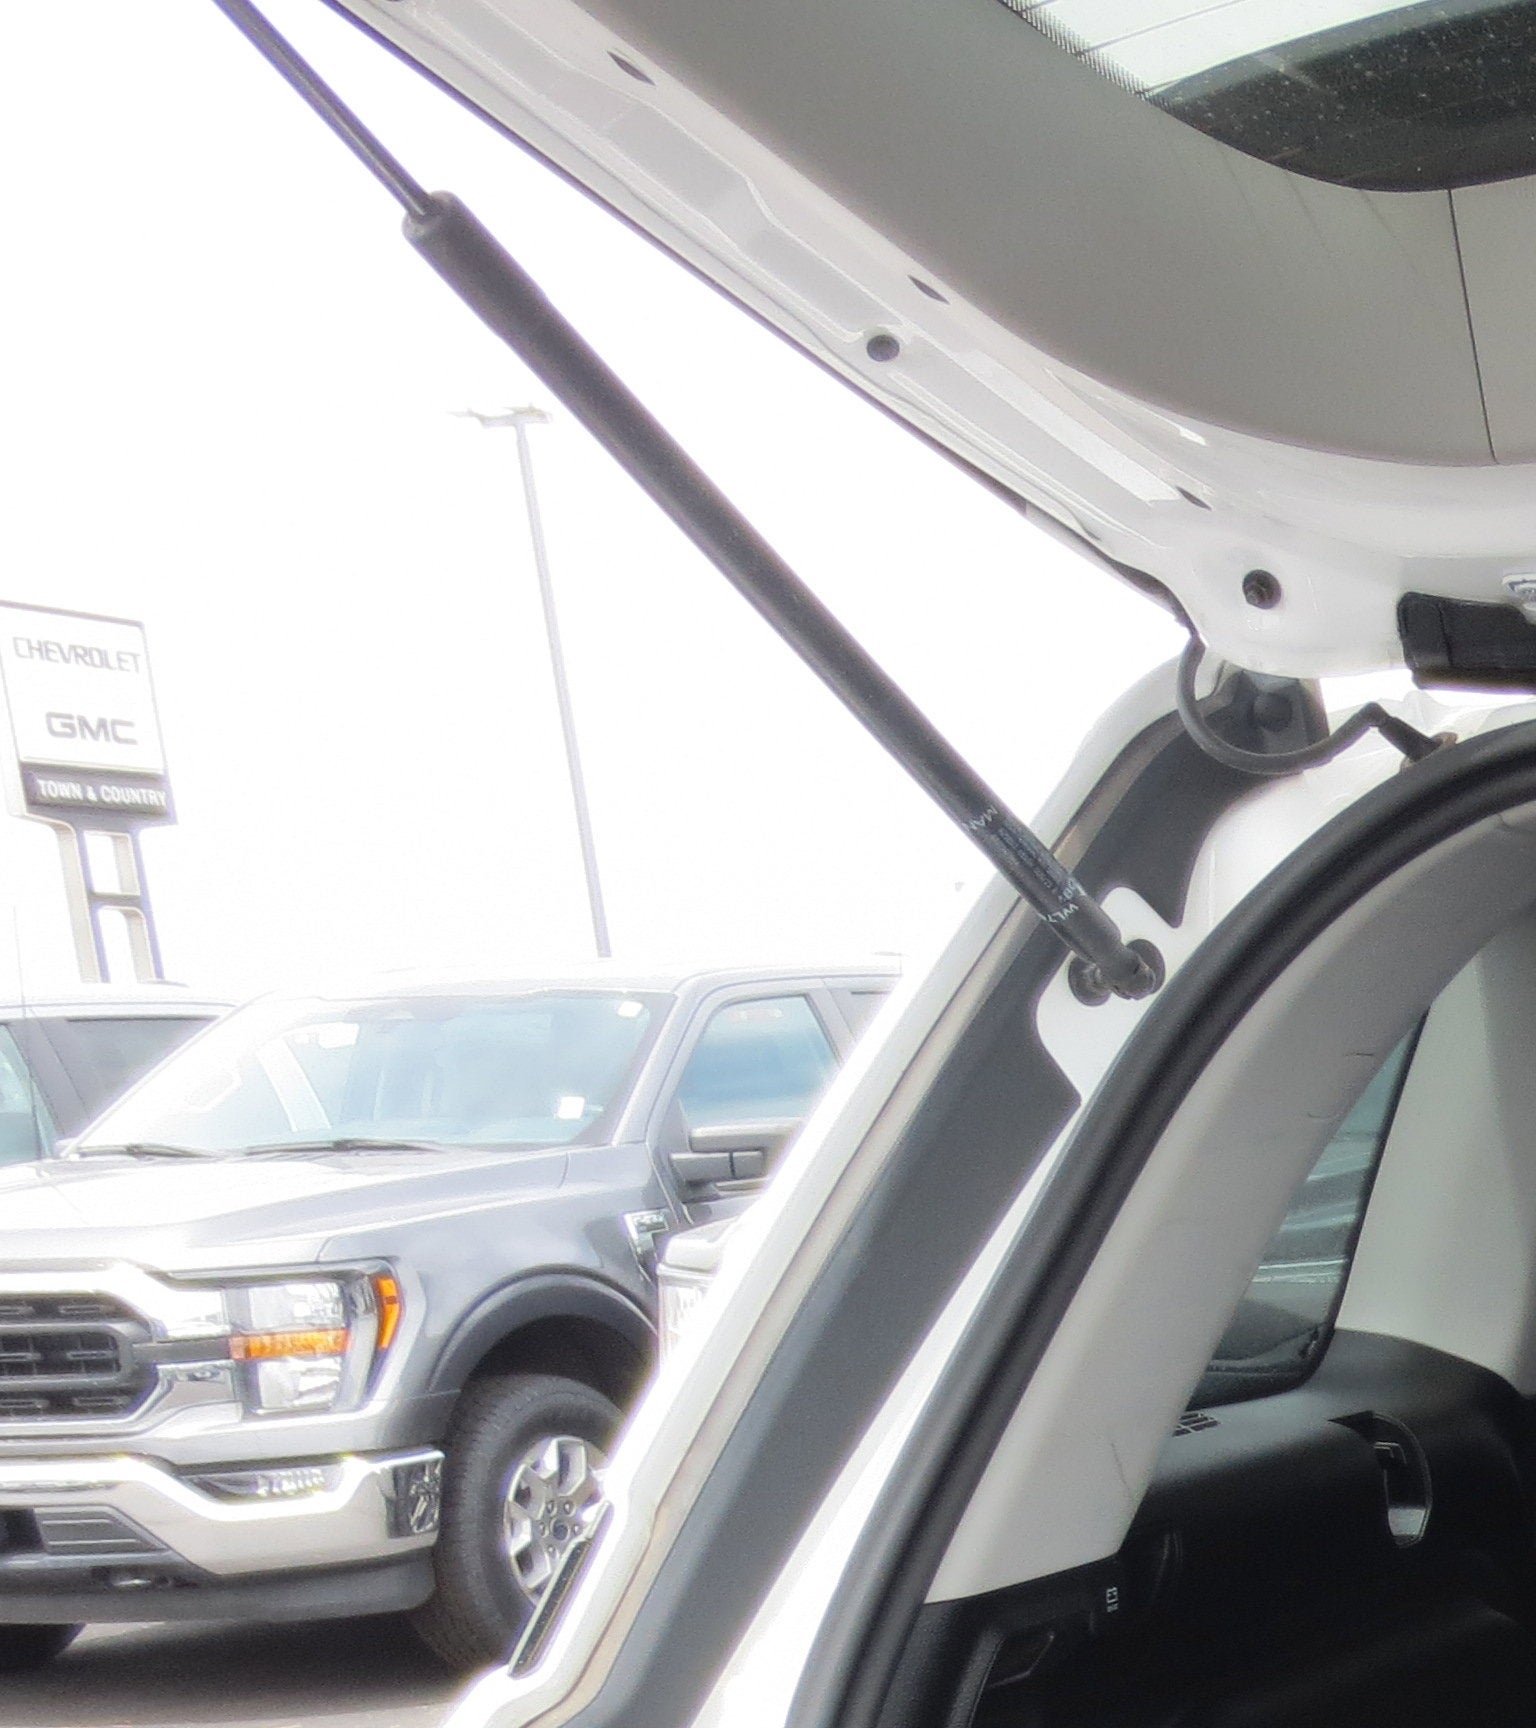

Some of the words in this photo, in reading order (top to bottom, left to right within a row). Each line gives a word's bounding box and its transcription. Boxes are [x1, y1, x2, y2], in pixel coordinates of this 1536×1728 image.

[12, 635, 142, 674] CHEVROLET
[45, 711, 138, 745] GMC
[38, 779, 84, 801] TOWN
[86, 784, 98, 802] &
[100, 784, 167, 808] COUNTRY
